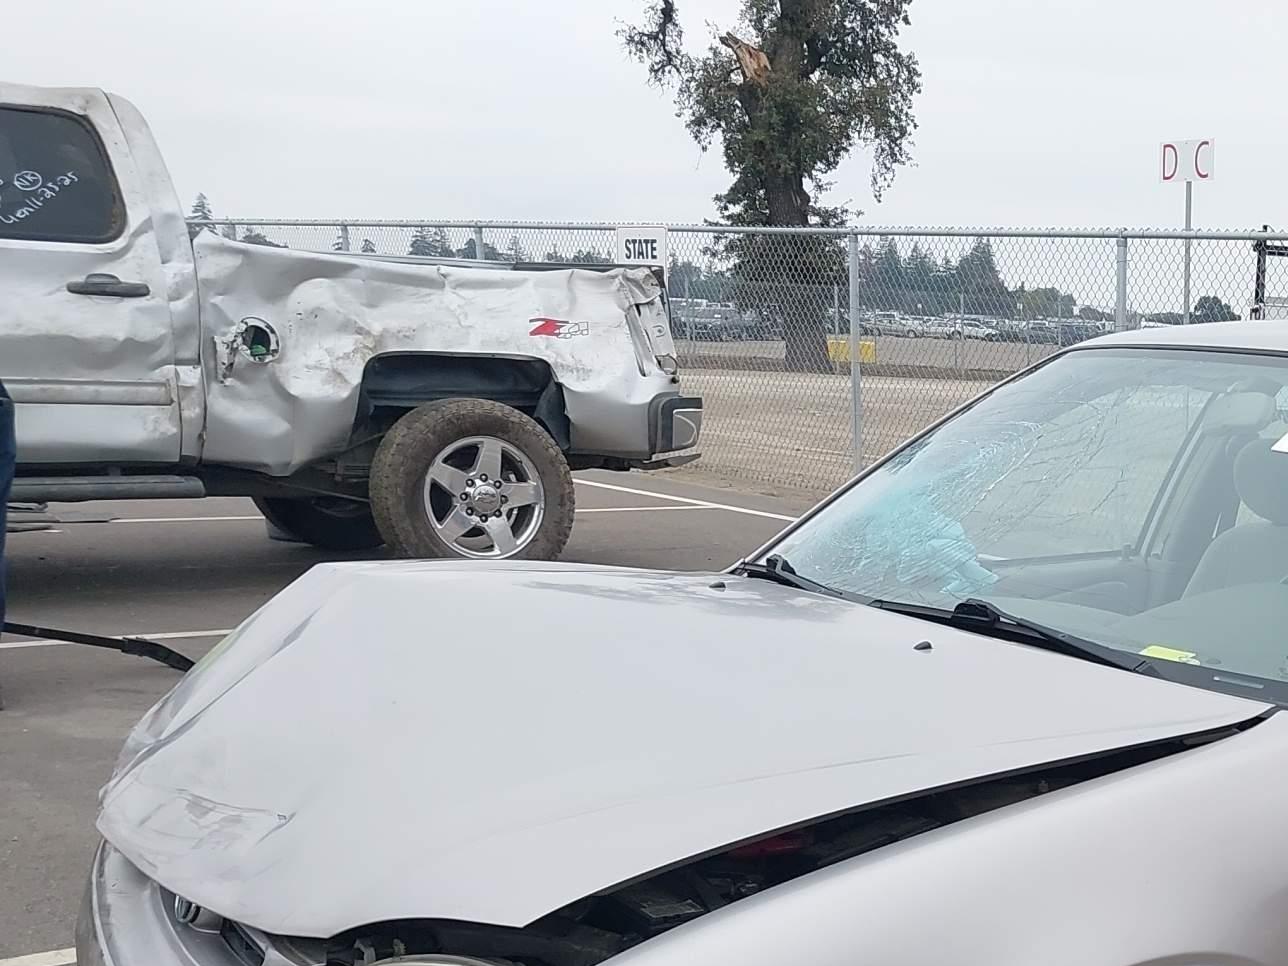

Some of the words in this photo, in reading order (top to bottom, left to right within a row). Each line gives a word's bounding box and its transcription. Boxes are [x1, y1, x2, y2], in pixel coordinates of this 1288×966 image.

[1162, 143, 1178, 181] D
[1194, 140, 1210, 179] C
[624, 238, 658, 260] STATE
